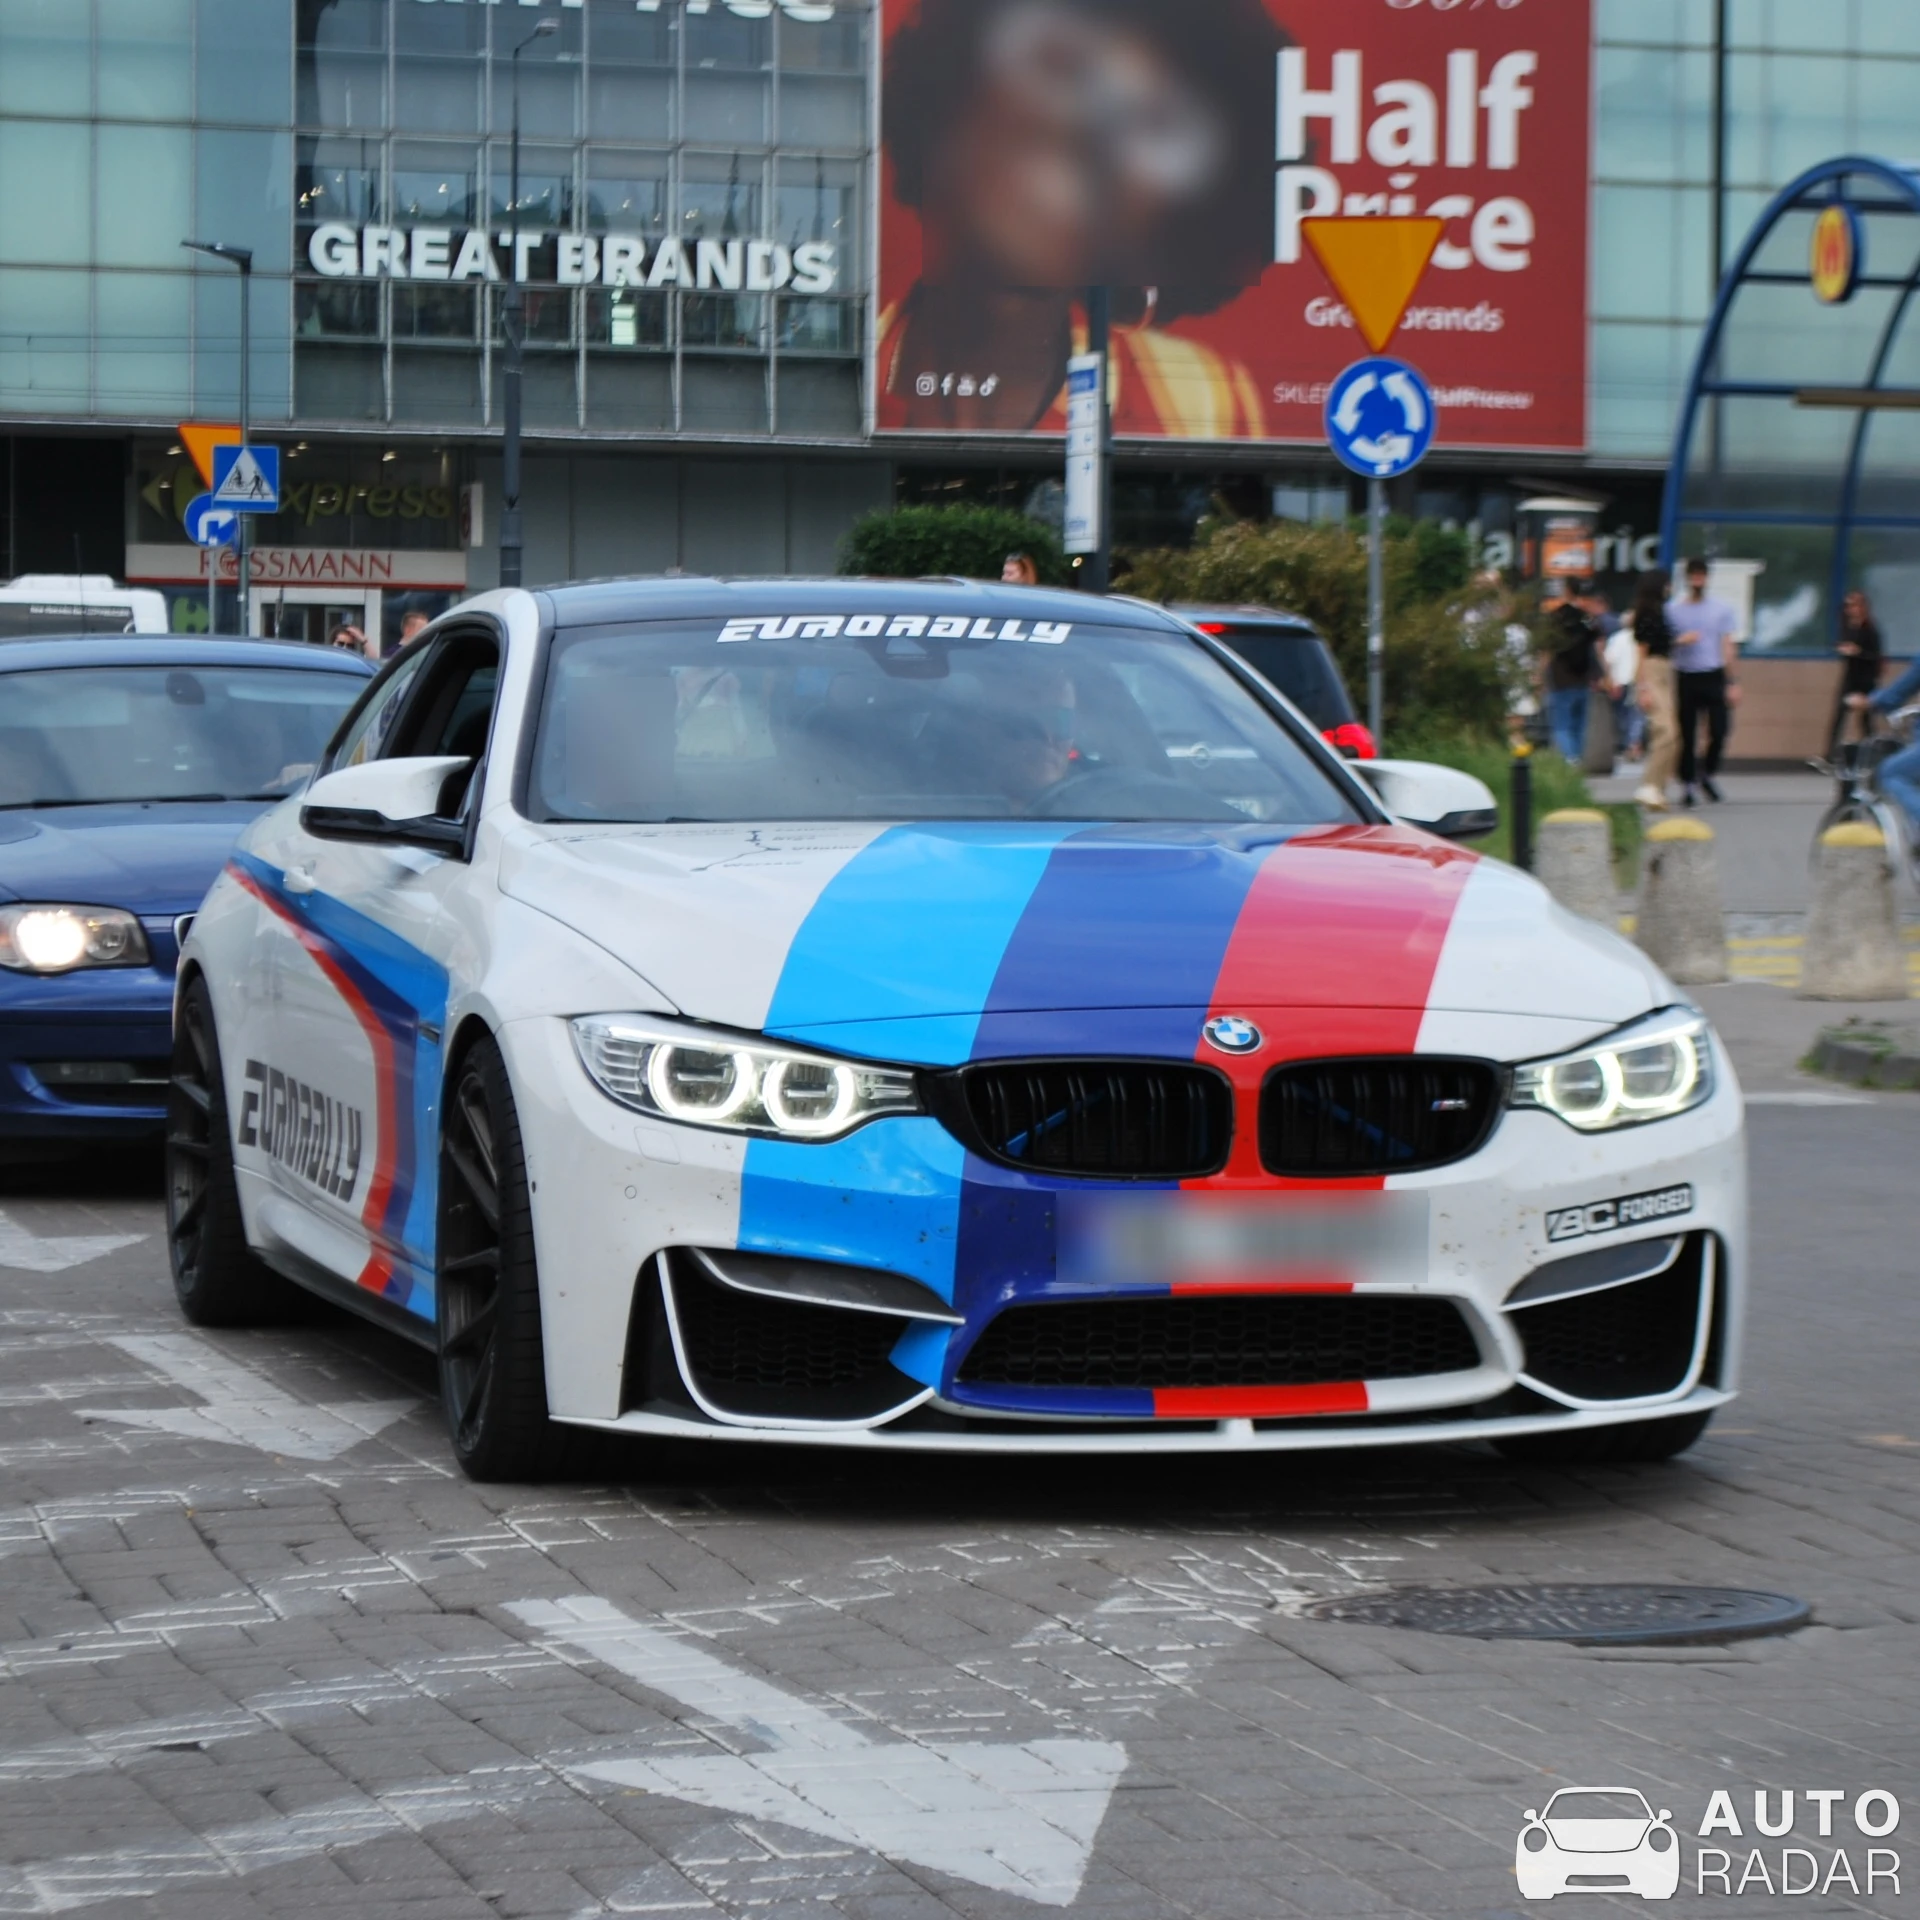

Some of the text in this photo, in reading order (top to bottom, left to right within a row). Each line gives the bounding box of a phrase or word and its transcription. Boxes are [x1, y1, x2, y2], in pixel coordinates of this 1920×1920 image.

[1275, 46, 1539, 170] Half
[308, 222, 837, 294] GREAT BRANDS
[1304, 296, 1356, 328] Gre
[279, 481, 453, 527] xpress
[1593, 524, 1663, 572] ric
[716, 614, 1073, 645] EURORALLY
[237, 1058, 362, 1203] EURORALLY
[1618, 1187, 1692, 1223] FORGED
